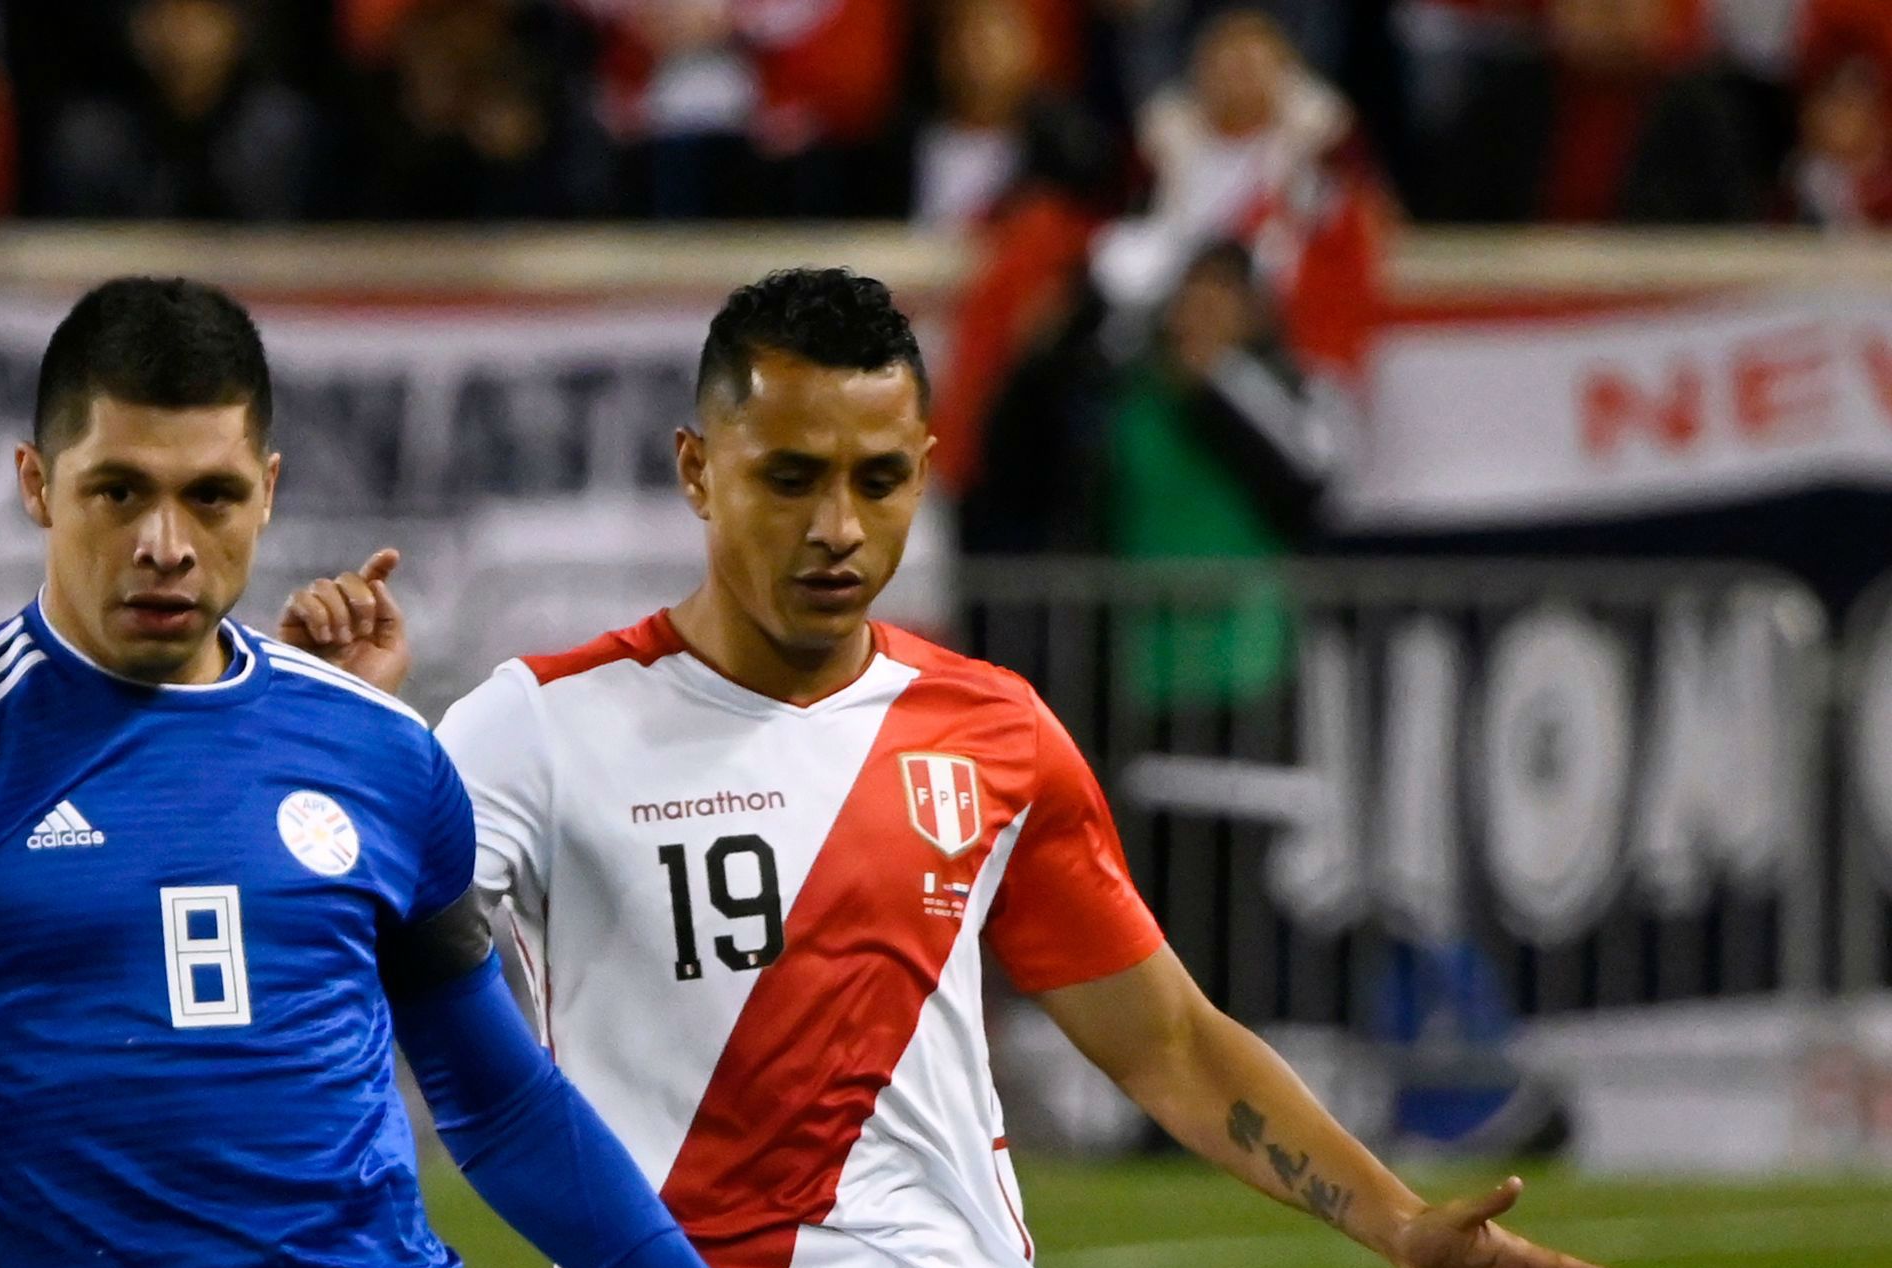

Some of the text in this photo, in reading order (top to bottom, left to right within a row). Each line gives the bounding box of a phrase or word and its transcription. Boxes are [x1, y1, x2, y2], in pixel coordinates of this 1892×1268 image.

[631, 790, 785, 825] marathon
[916, 786, 971, 811] FPF
[26, 830, 106, 850] adidas
[658, 833, 785, 982] 19
[159, 884, 252, 1030] 8
